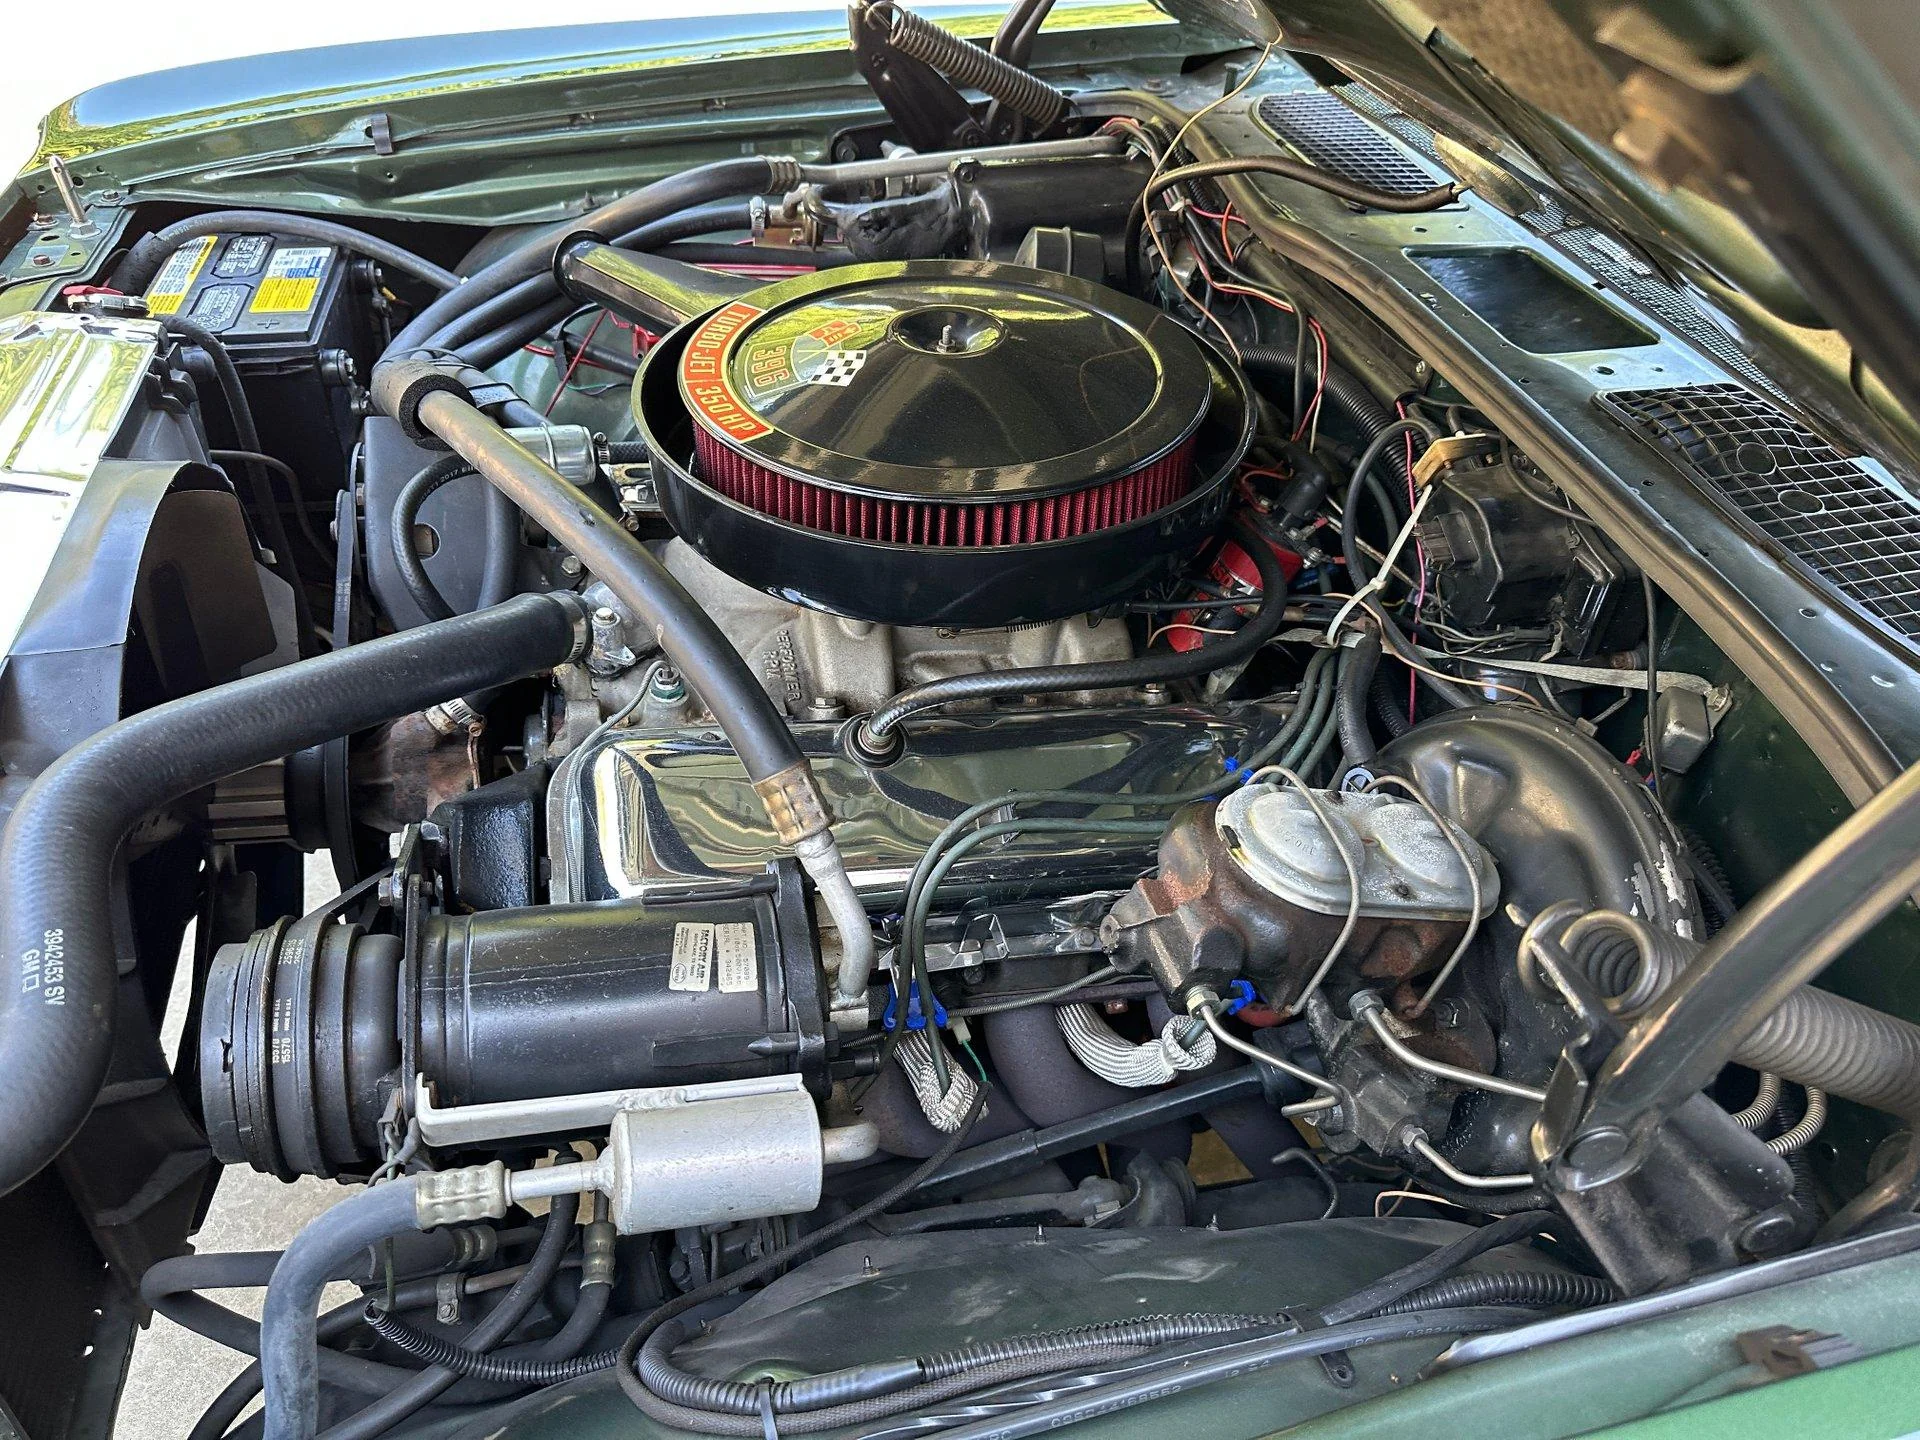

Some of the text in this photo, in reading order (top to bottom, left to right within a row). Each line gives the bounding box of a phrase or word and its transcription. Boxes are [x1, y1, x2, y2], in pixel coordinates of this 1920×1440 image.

[690, 310, 751, 375] TURBO-JET
[752, 345, 790, 387] 396
[440, 469, 459, 482] 2017
[762, 650, 782, 680] RPM
[776, 630, 802, 702] PERFORMER
[698, 929, 710, 963] FACTORY
[44, 928, 65, 1005] 3942453 SV
[281, 1037, 291, 1064] 15570
